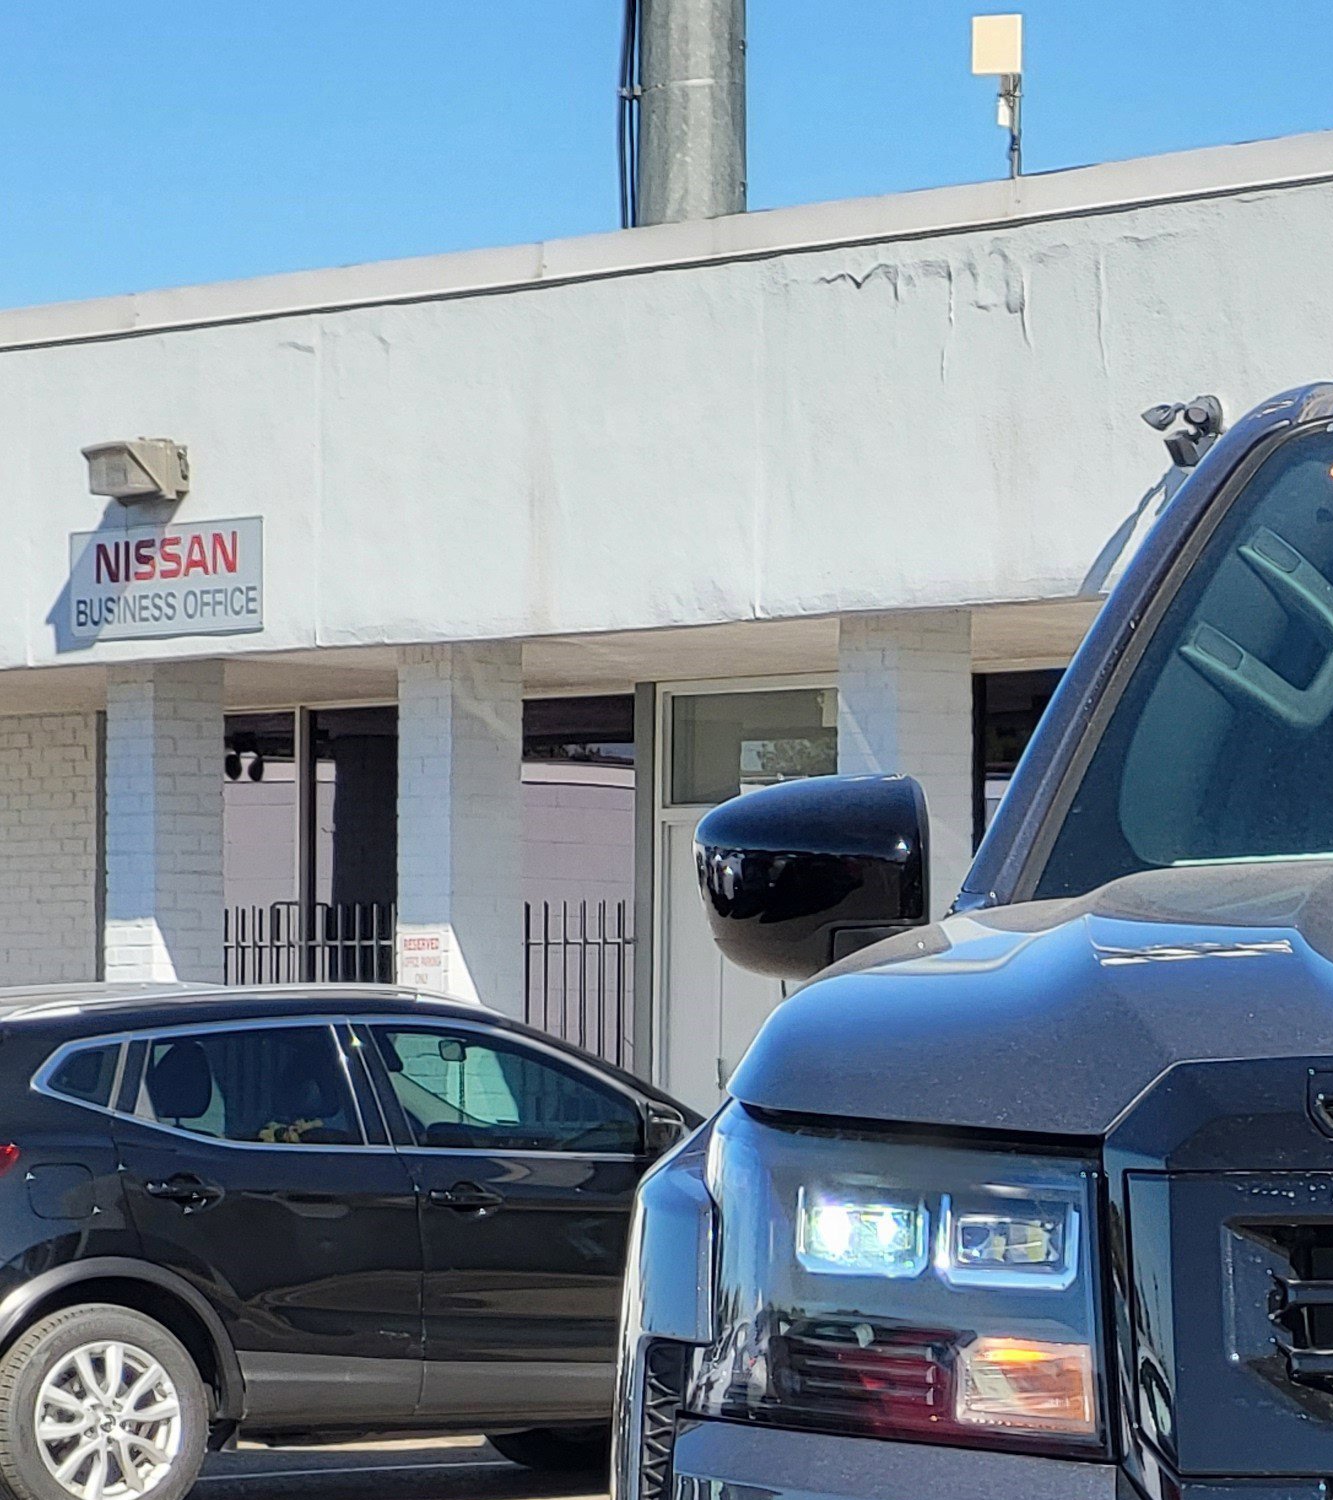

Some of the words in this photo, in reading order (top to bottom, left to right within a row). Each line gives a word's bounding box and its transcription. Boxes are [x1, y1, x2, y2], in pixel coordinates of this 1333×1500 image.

[96, 531, 237, 583] NISSAN
[76, 591, 177, 627] BUSINESS
[183, 586, 258, 620] OFFICE
